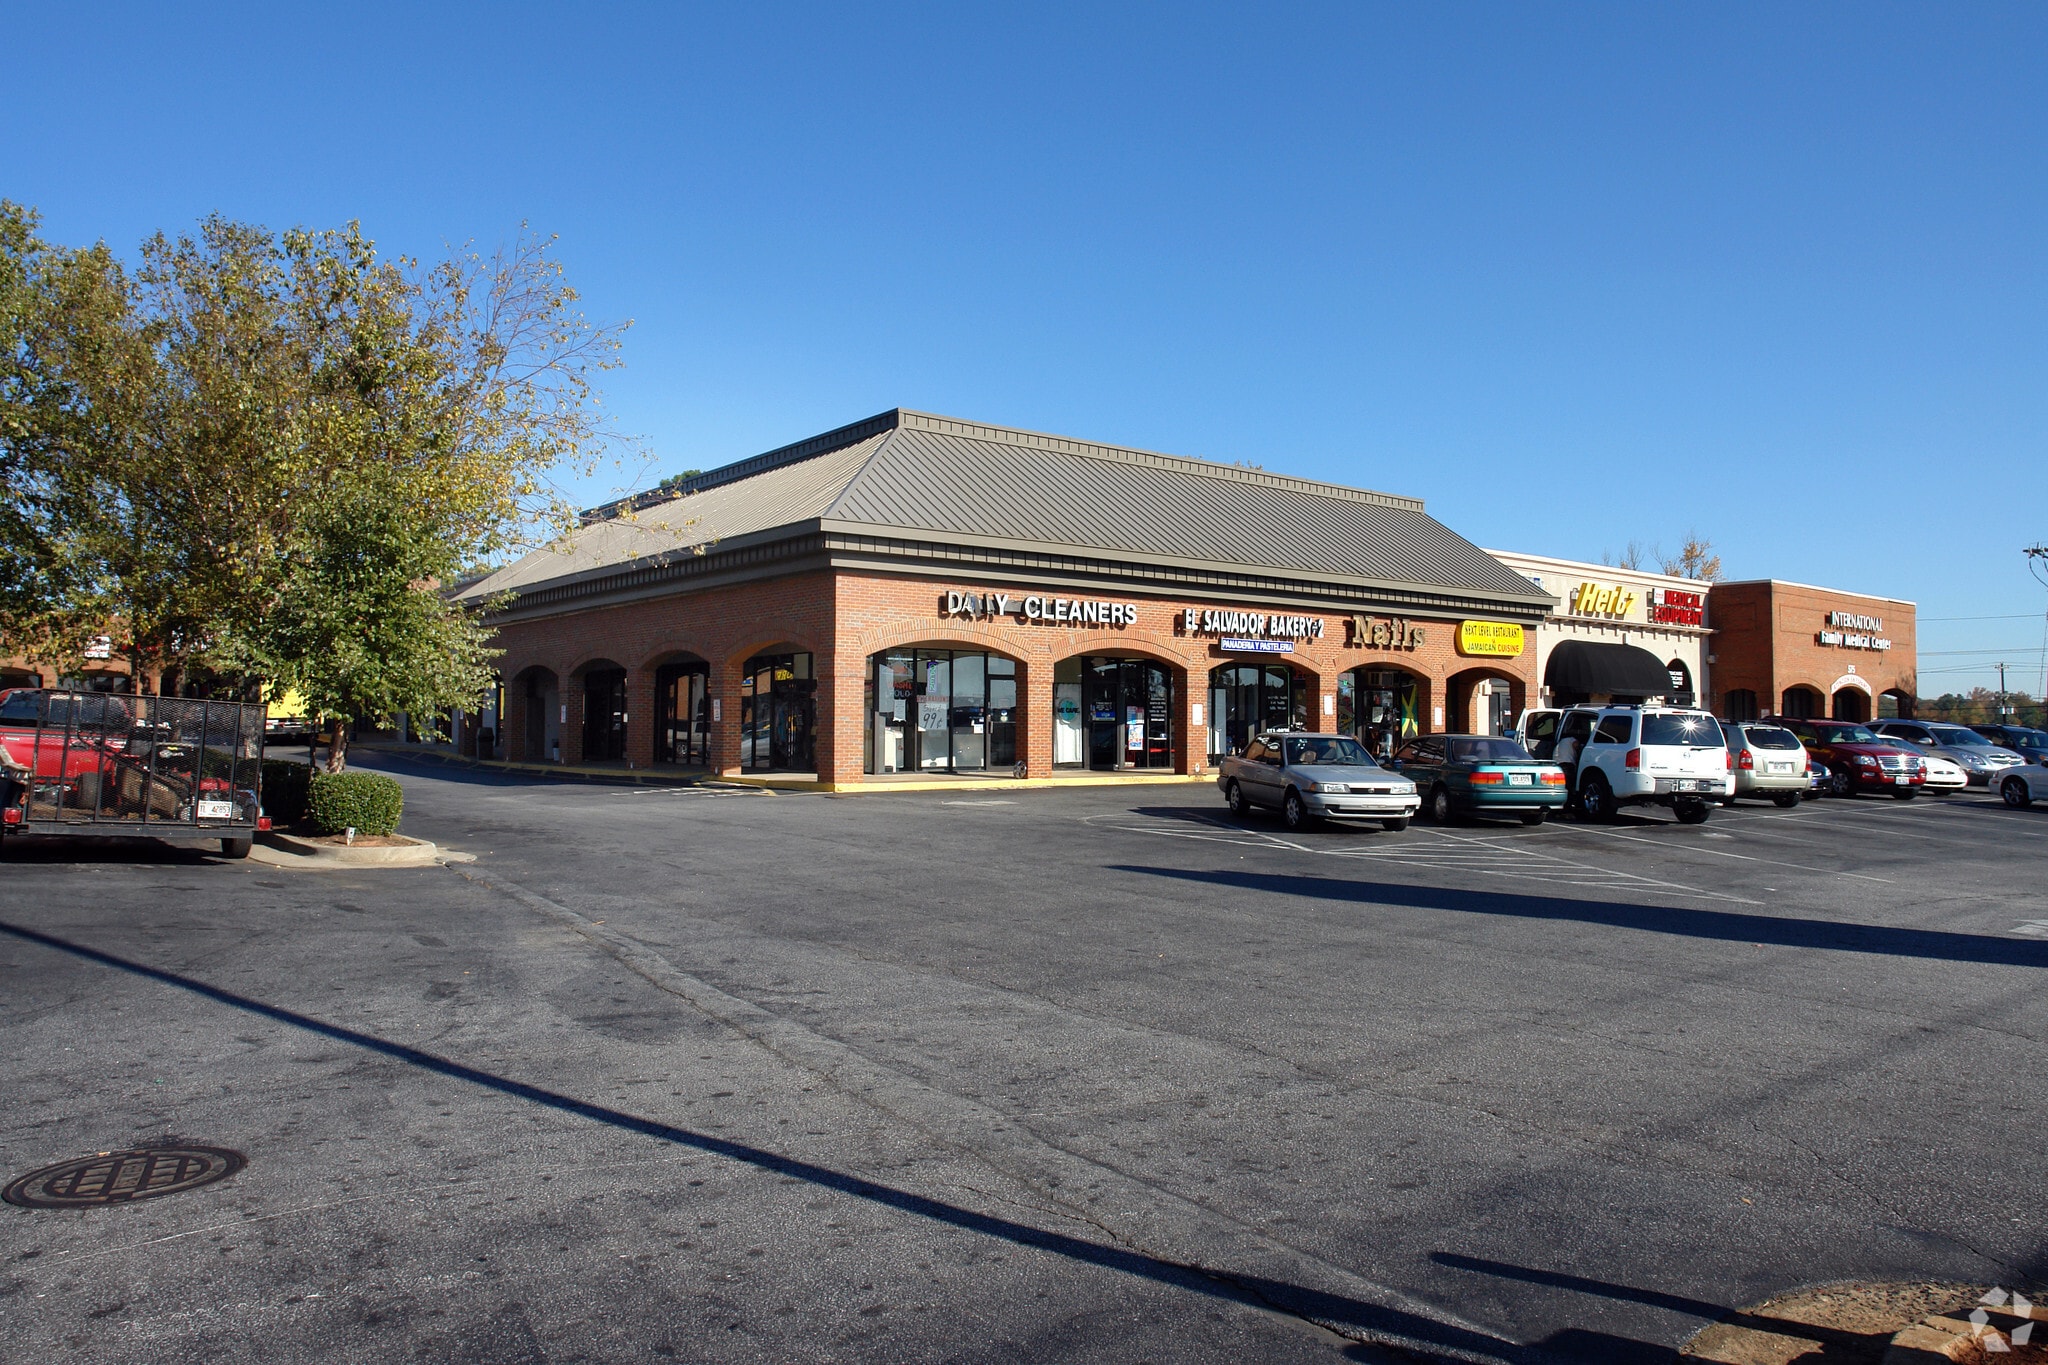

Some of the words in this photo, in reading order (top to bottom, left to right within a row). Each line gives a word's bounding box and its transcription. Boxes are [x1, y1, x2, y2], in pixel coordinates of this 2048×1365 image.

[1576, 582, 1640, 615] Hertz
[1664, 589, 1703, 609] MEDICAL
[1024, 595, 1138, 625] CLEANERS
[1653, 606, 1704, 626] EQUIPMENT
[1831, 610, 1883, 632] INTERNATIONAL
[1184, 608, 1199, 631] EL
[1204, 609, 1265, 635] SALVADOR
[1270, 615, 1313, 637] BAKERY
[1352, 615, 1426, 648] Nails
[1467, 642, 1497, 652] JAMAICAN
[1497, 644, 1520, 653] CUISINE
[1821, 630, 1844, 647] Family
[1844, 633, 1870, 648] Medical
[1871, 636, 1892, 650] Center
